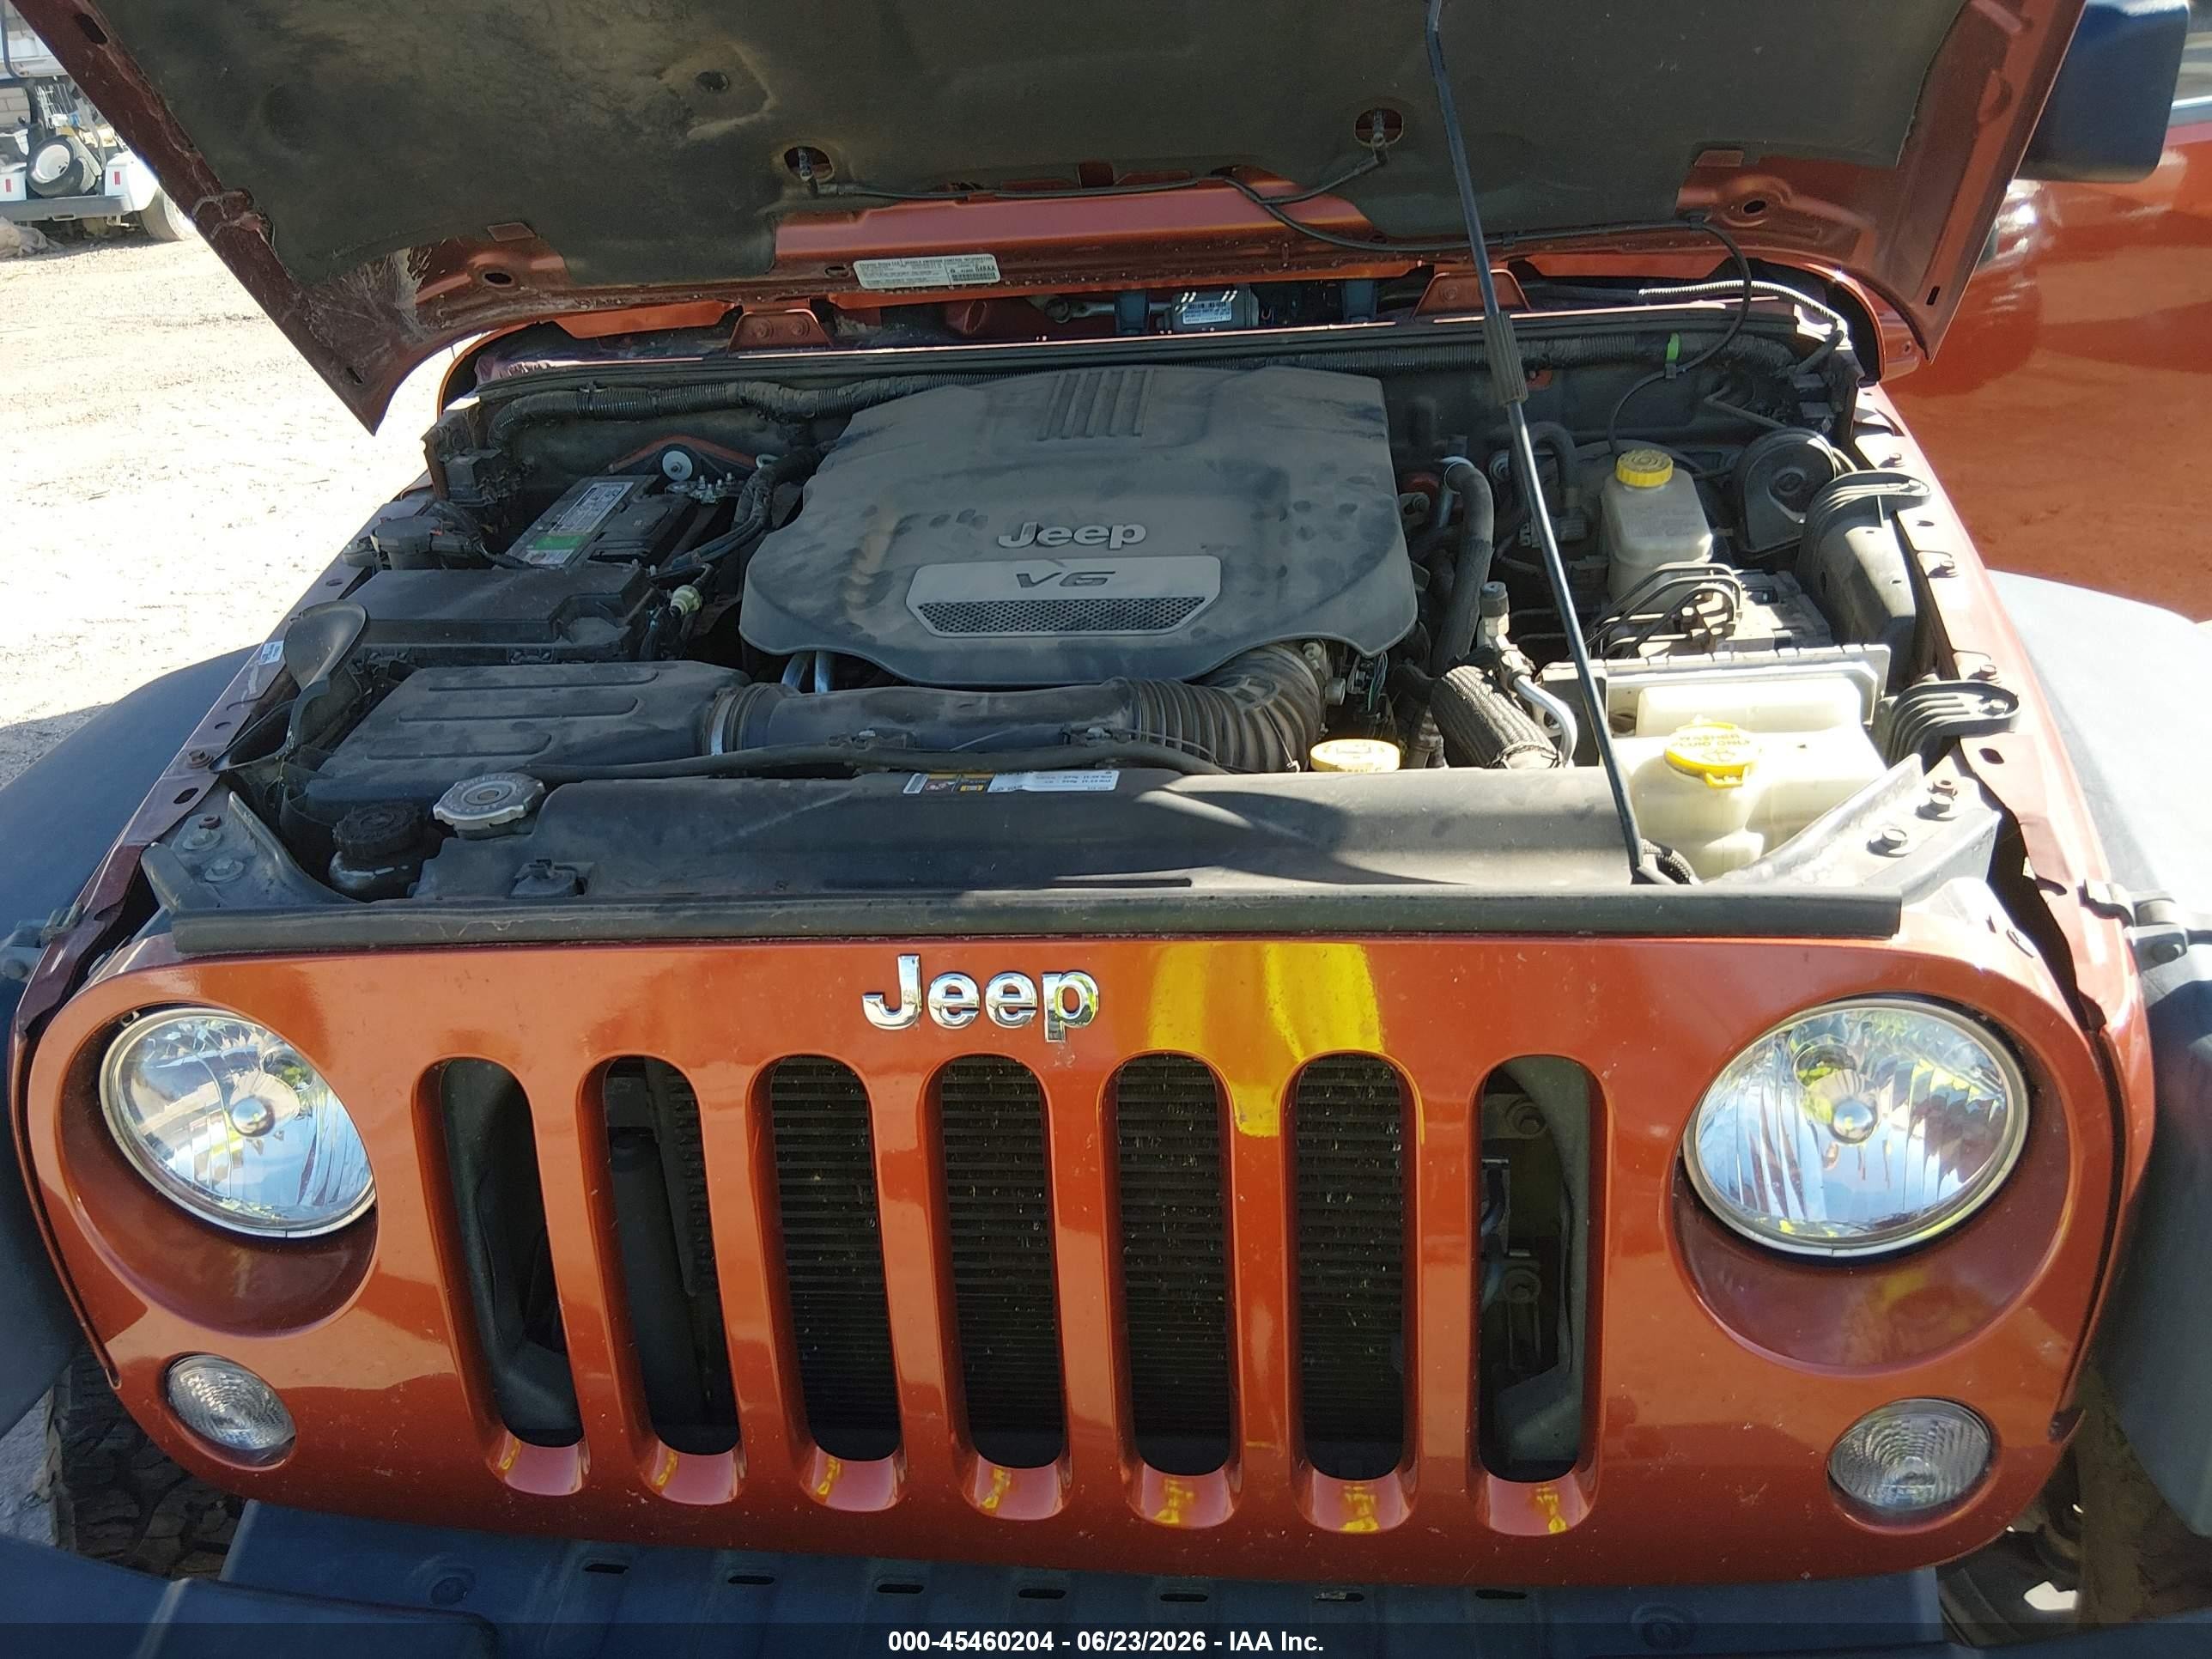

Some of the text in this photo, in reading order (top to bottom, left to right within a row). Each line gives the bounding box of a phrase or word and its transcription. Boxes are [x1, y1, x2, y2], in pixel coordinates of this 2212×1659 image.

[998, 521, 1146, 550] Jeep
[1016, 571, 1115, 588] V6
[1679, 733, 1740, 742] WASHER
[862, 953, 1099, 1042] Jeep
